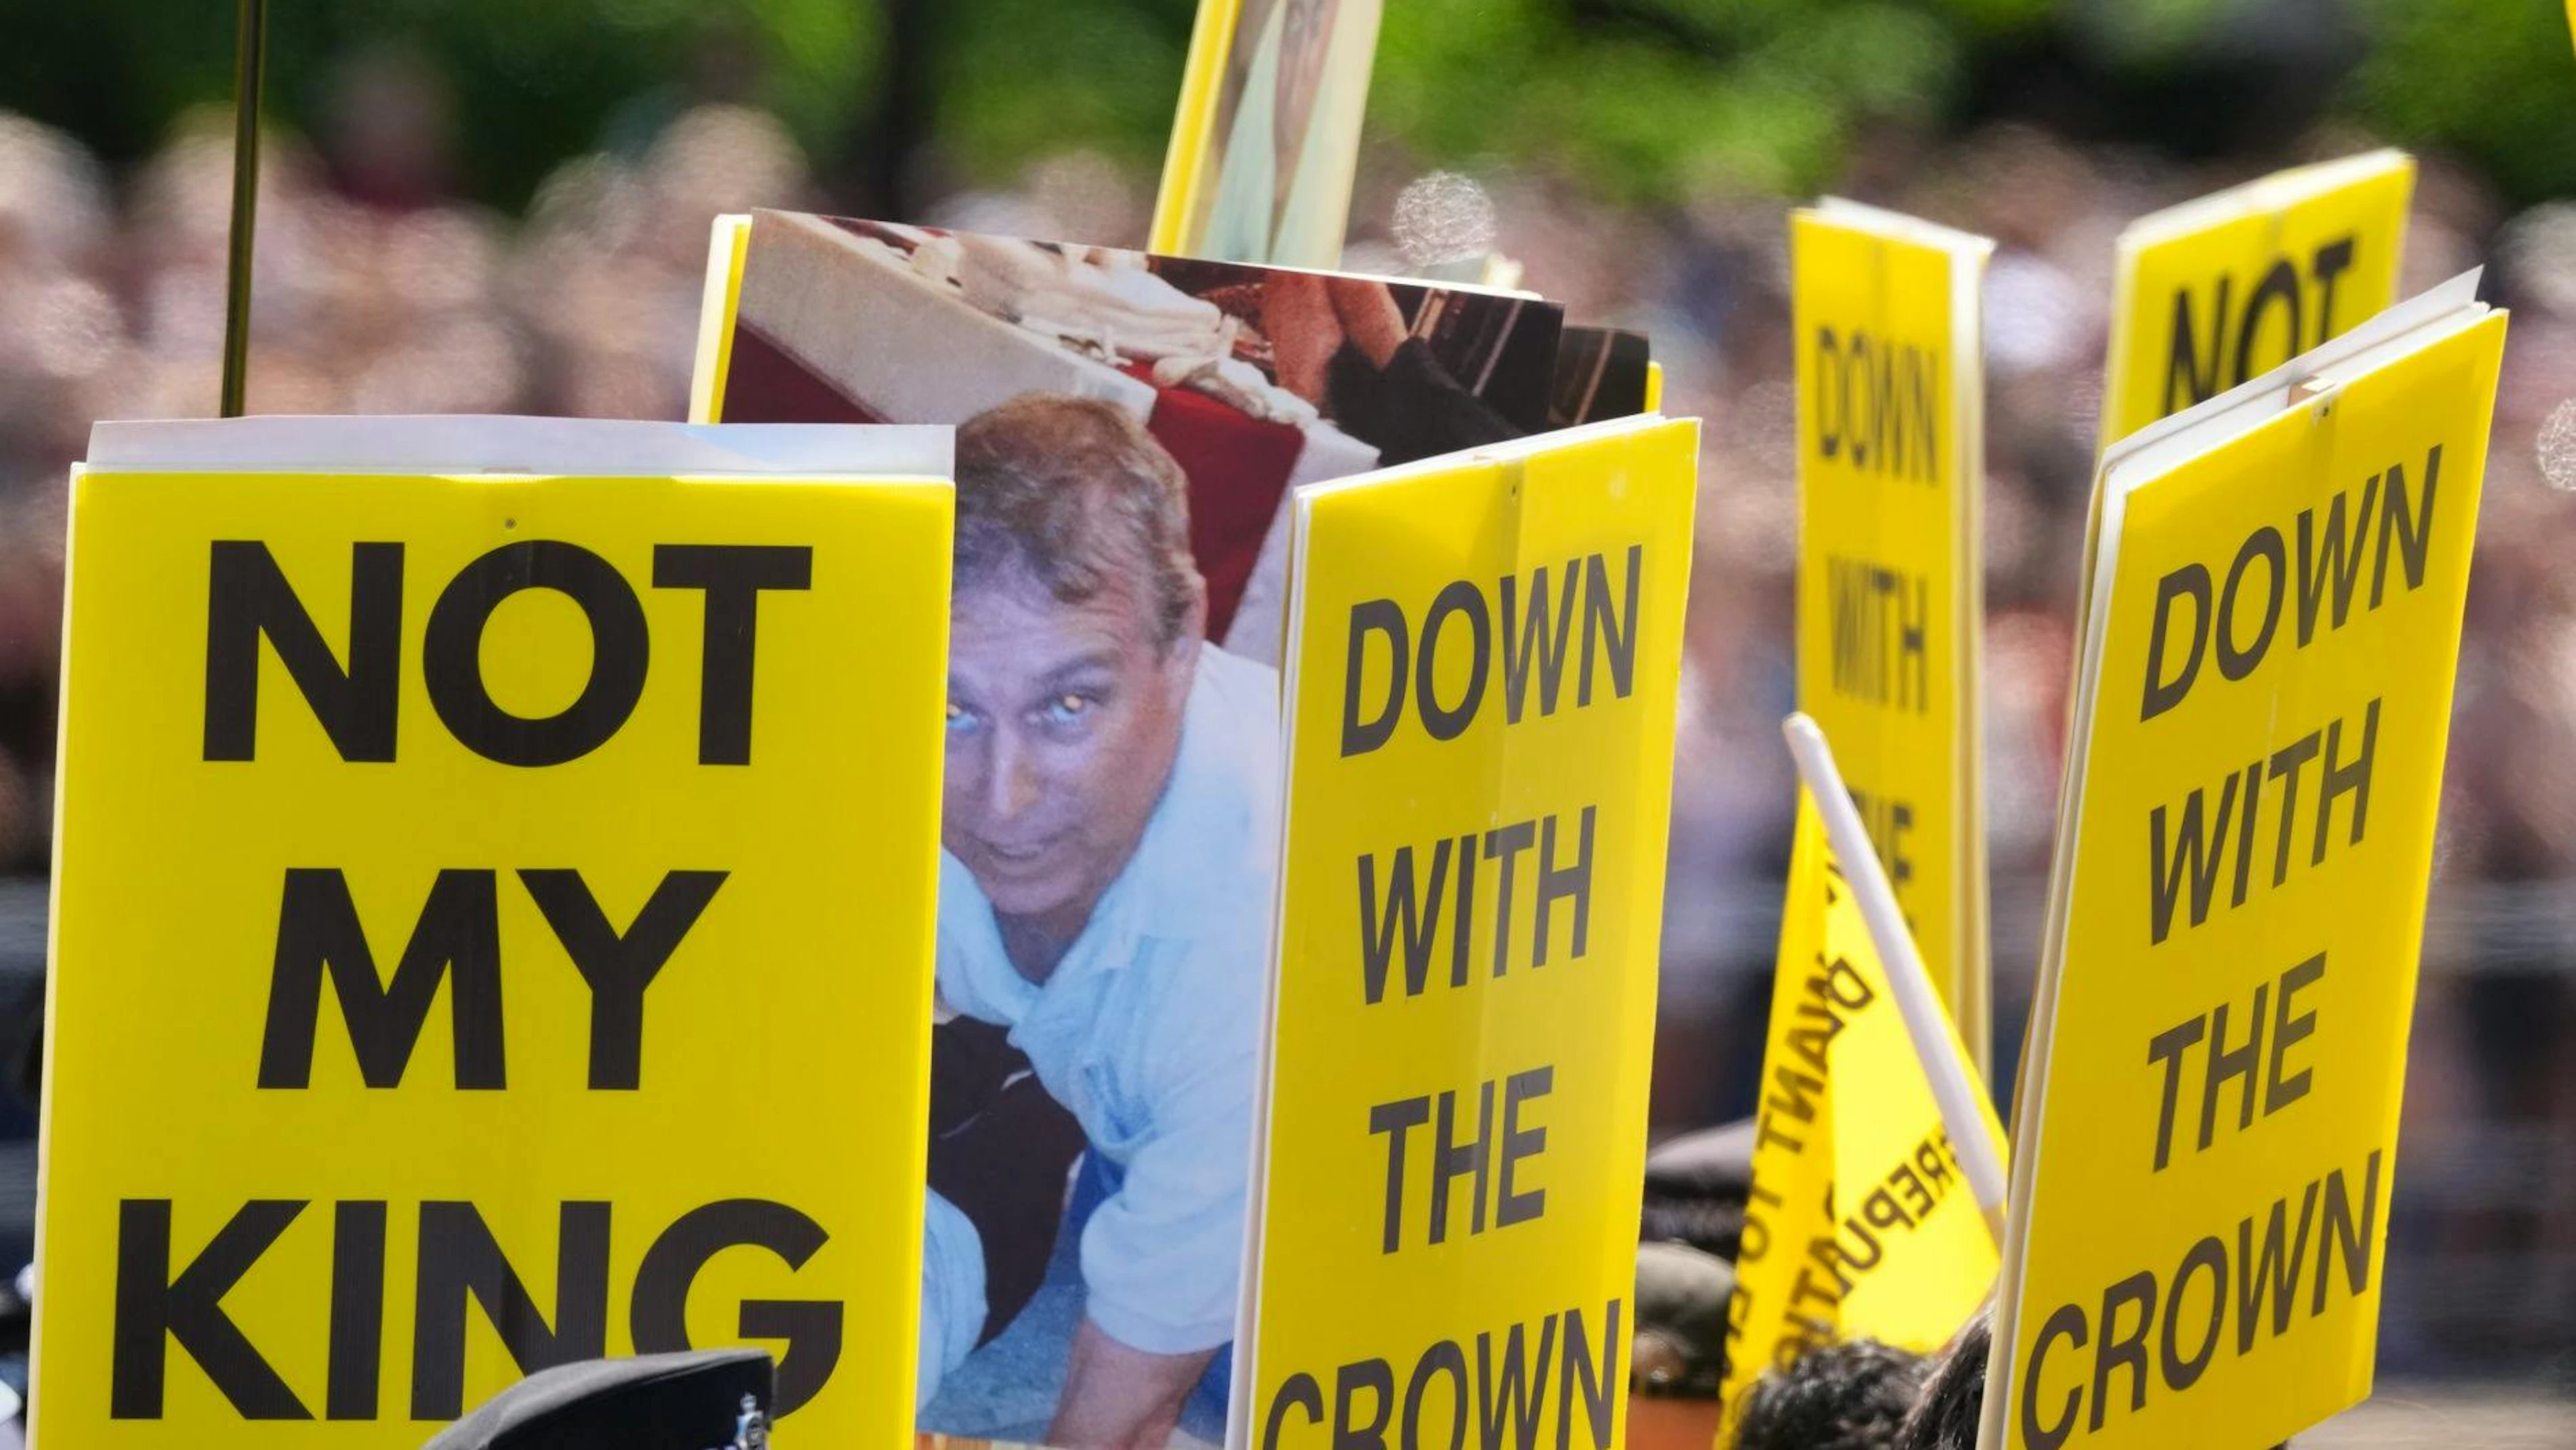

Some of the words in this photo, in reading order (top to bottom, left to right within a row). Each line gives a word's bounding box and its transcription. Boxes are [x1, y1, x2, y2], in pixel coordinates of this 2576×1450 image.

[1815, 323, 1938, 486] DOWN
[2163, 236, 2356, 417] NOT
[203, 539, 813, 768] NOT
[1340, 546, 1642, 758] DOWN
[1827, 556, 1929, 714] WITH
[2140, 444, 2442, 723] DOWN
[1357, 806, 1597, 1006] WITH
[2149, 697, 2381, 946] WITH
[257, 868, 731, 1091] MY
[2147, 949, 2326, 1173] THE
[1368, 1065, 1554, 1256] THE
[109, 1198, 844, 1422] KING
[2021, 1149, 2383, 1450] CROWN
